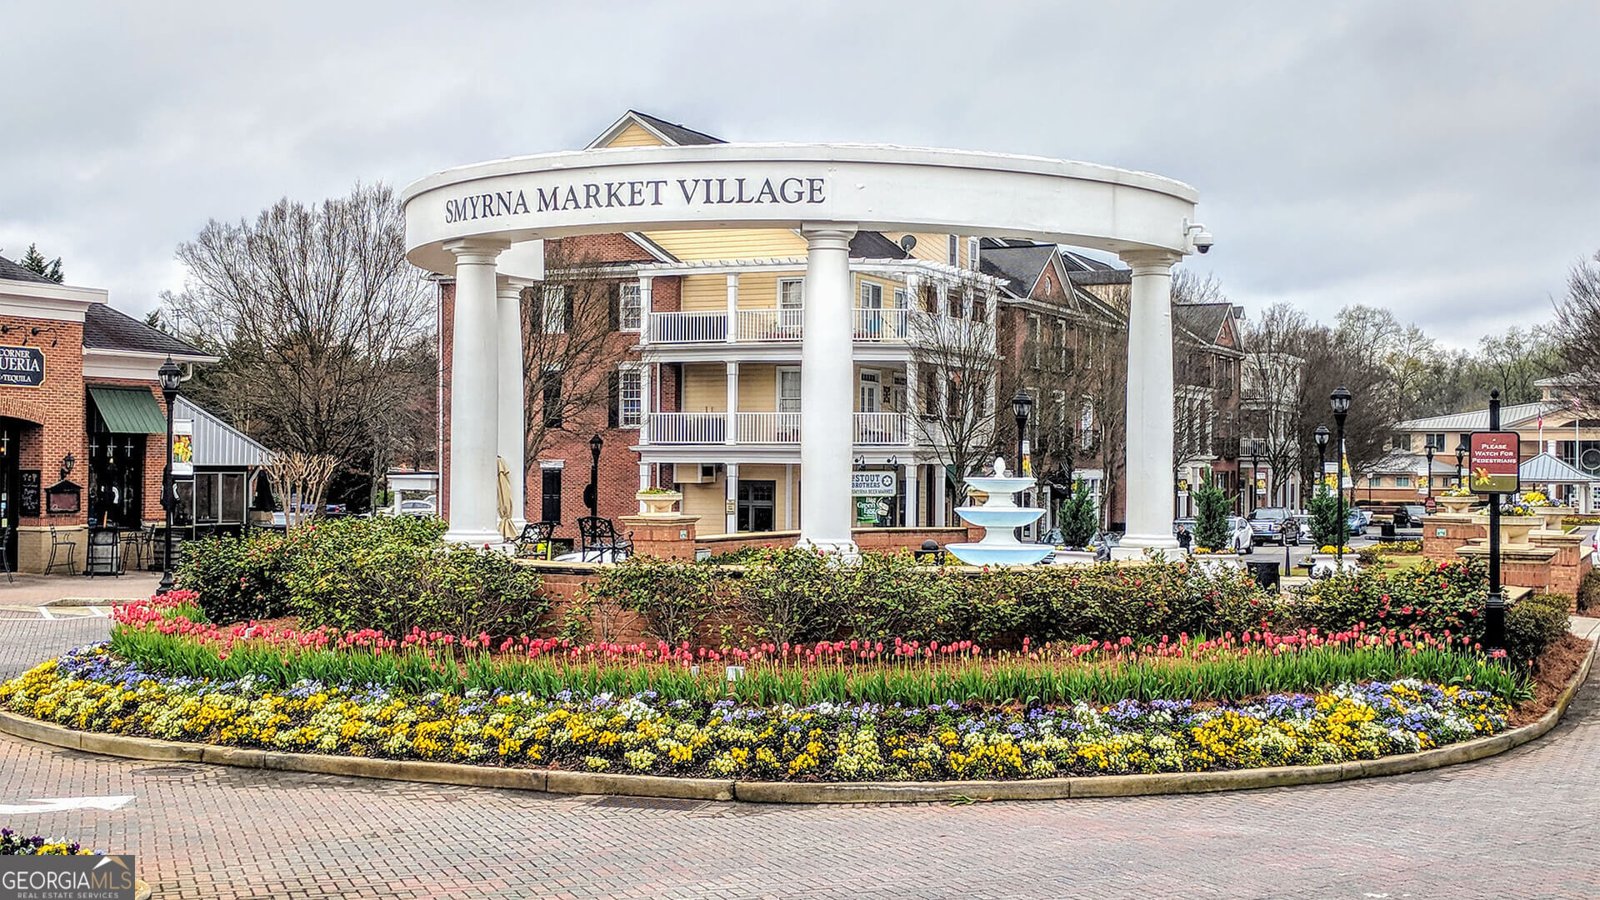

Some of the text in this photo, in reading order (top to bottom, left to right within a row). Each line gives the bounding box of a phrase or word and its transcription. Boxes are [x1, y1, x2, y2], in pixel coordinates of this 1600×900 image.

[445, 177, 827, 224] SMYRNA MARKET VILLAGE
